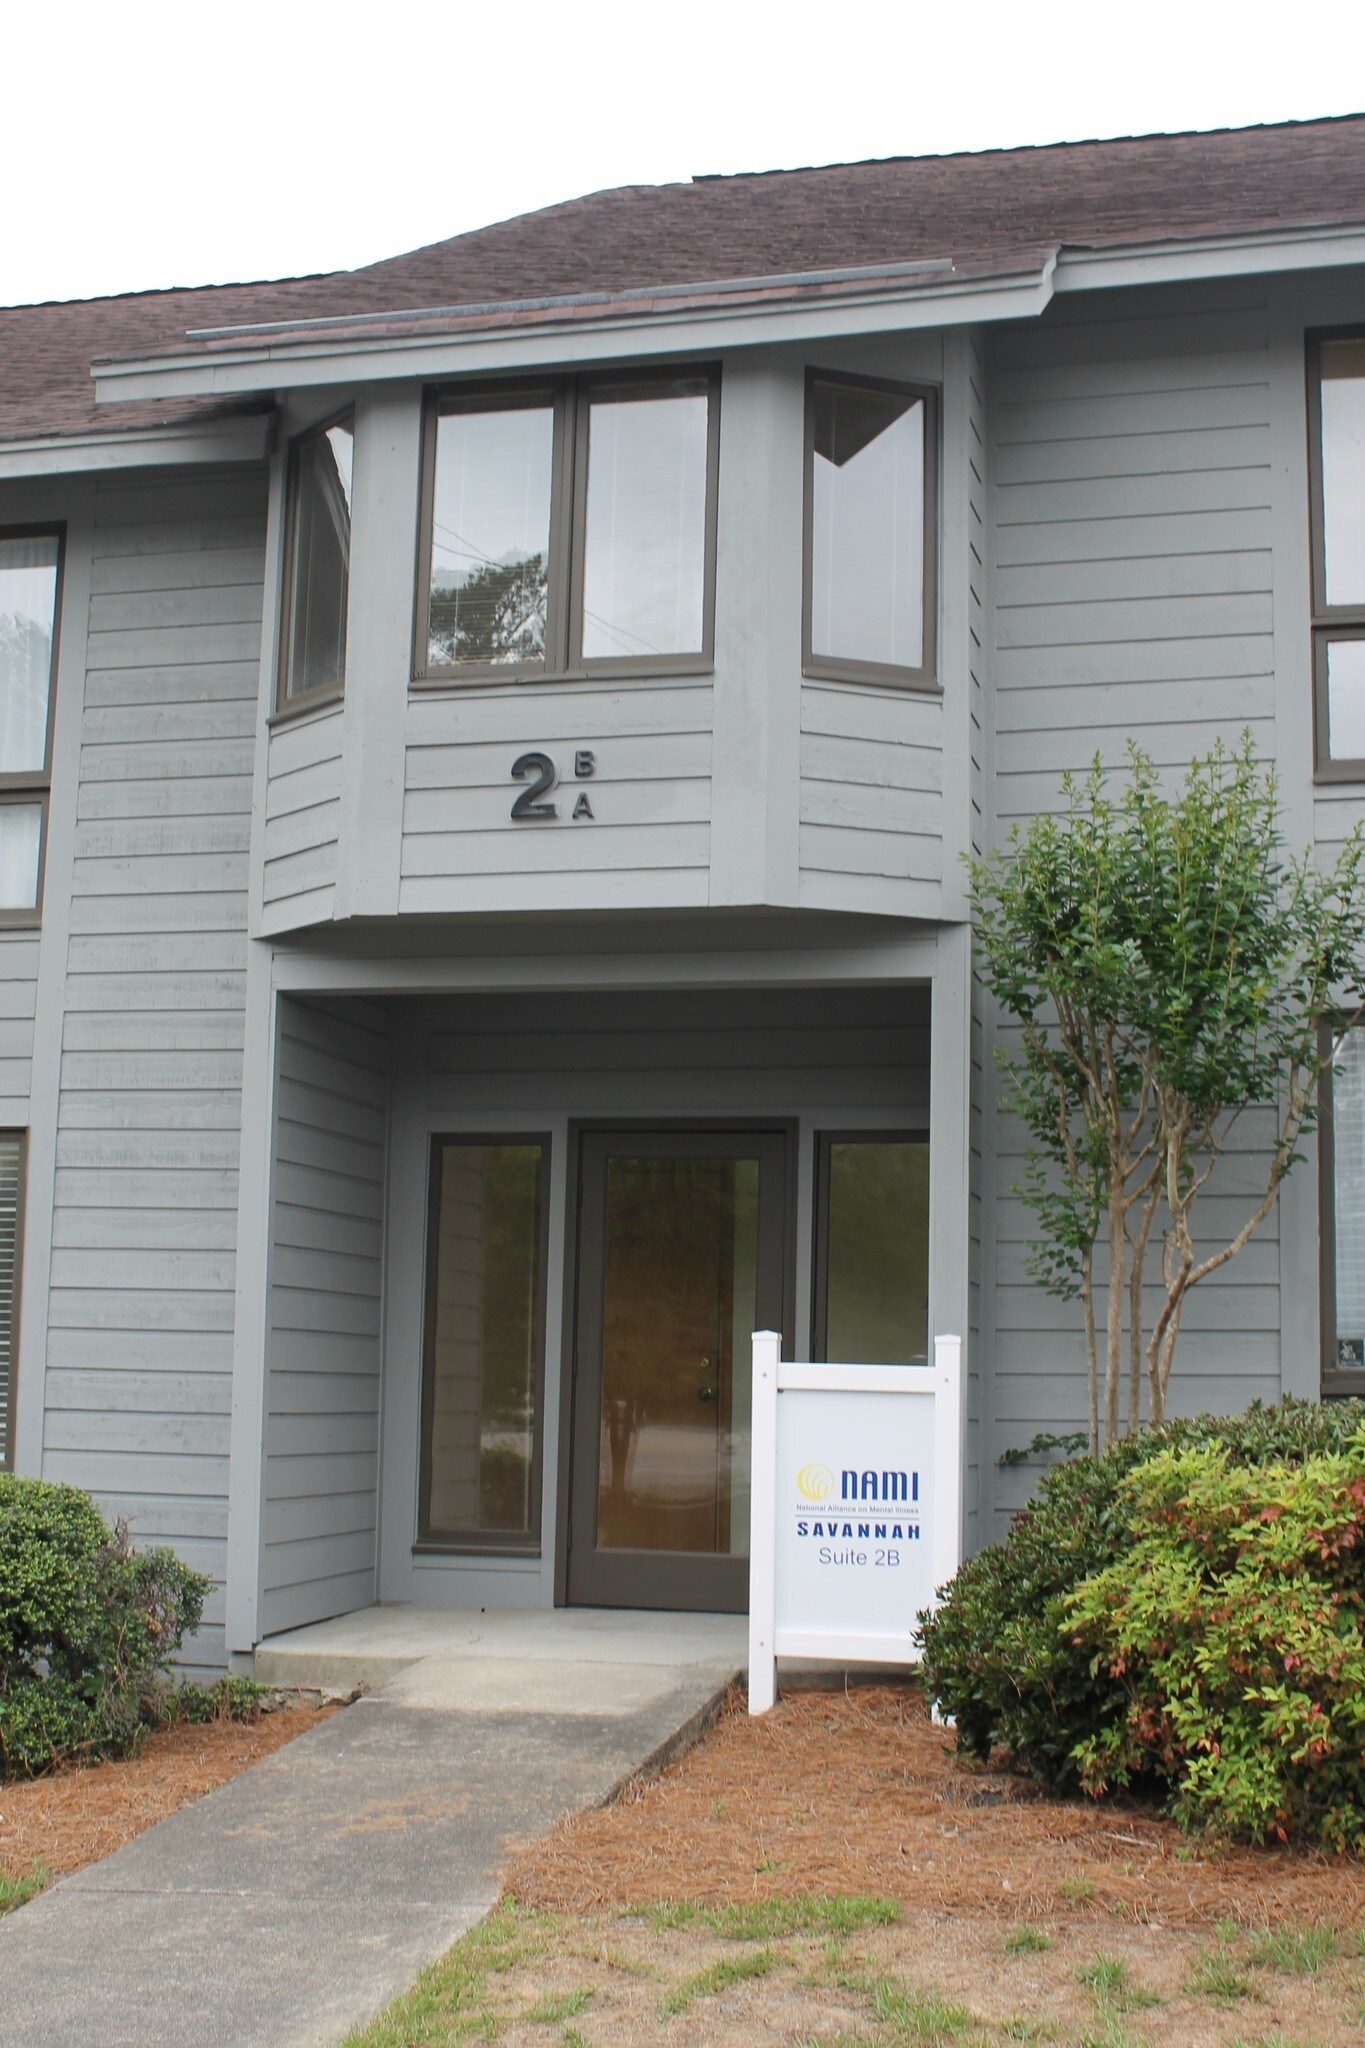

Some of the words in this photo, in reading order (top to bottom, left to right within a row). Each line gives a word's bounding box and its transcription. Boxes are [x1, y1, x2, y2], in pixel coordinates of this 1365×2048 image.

[575, 751, 595, 777] B
[511, 752, 557, 820] 2
[572, 792, 595, 819] A
[841, 1470, 919, 1501] NAMI
[796, 1504, 826, 1512] National
[827, 1504, 857, 1513] Alliance
[869, 1506, 894, 1514] Mental
[895, 1506, 920, 1515] Illness
[797, 1521, 920, 1540] SAVANNAH
[818, 1547, 868, 1566] Suite
[874, 1549, 901, 1567] 2B
